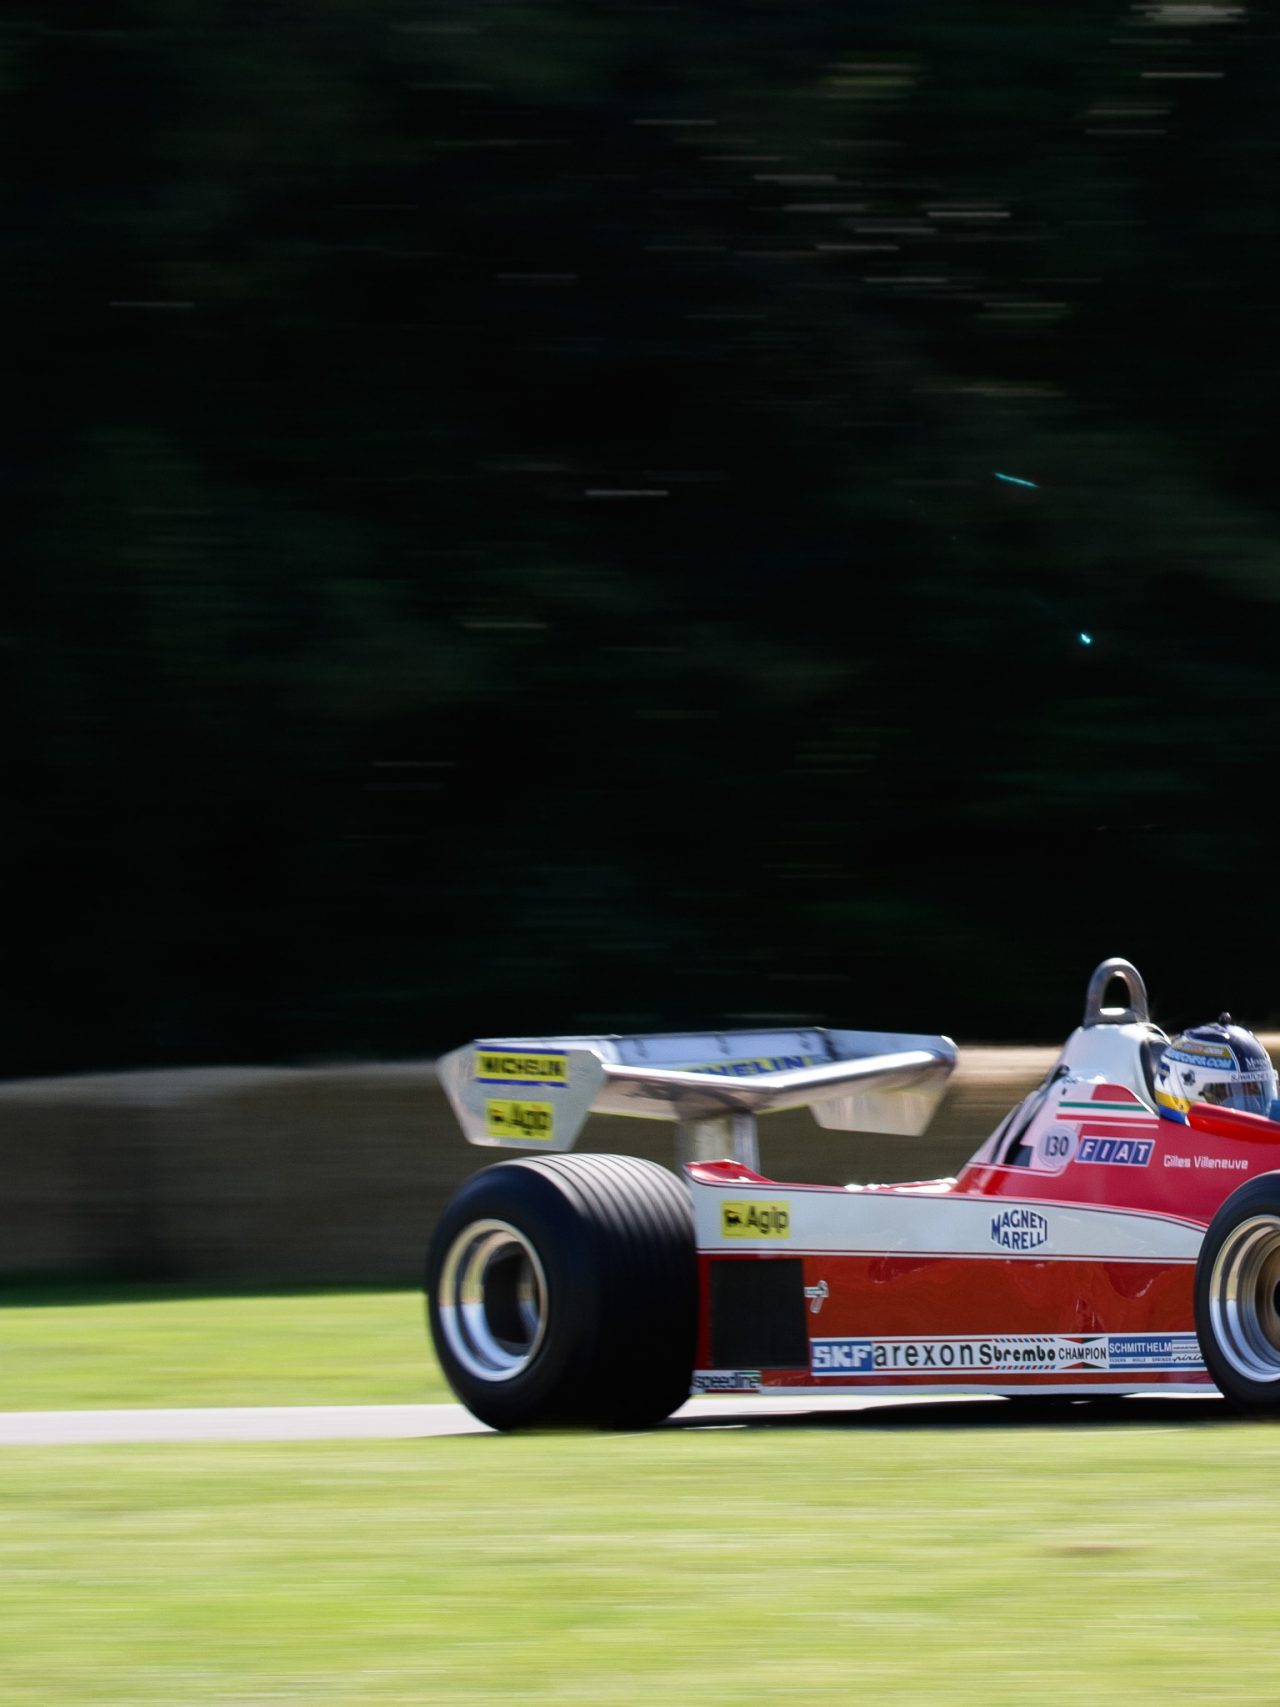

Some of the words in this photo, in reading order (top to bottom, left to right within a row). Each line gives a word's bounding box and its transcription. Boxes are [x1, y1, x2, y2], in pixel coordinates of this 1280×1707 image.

[481, 1056, 566, 1077] MICHELIN
[509, 1103, 550, 1136] Agip
[1081, 1141, 1150, 1162] FIAT
[1163, 1154, 1191, 1168] Gilles
[1193, 1155, 1249, 1170] Villeneuve
[744, 1205, 788, 1234] Agip
[812, 1345, 872, 1368] SKF
[873, 1343, 993, 1367] arexons
[994, 1345, 1056, 1362] brembo
[1058, 1347, 1107, 1361] CHAMPION
